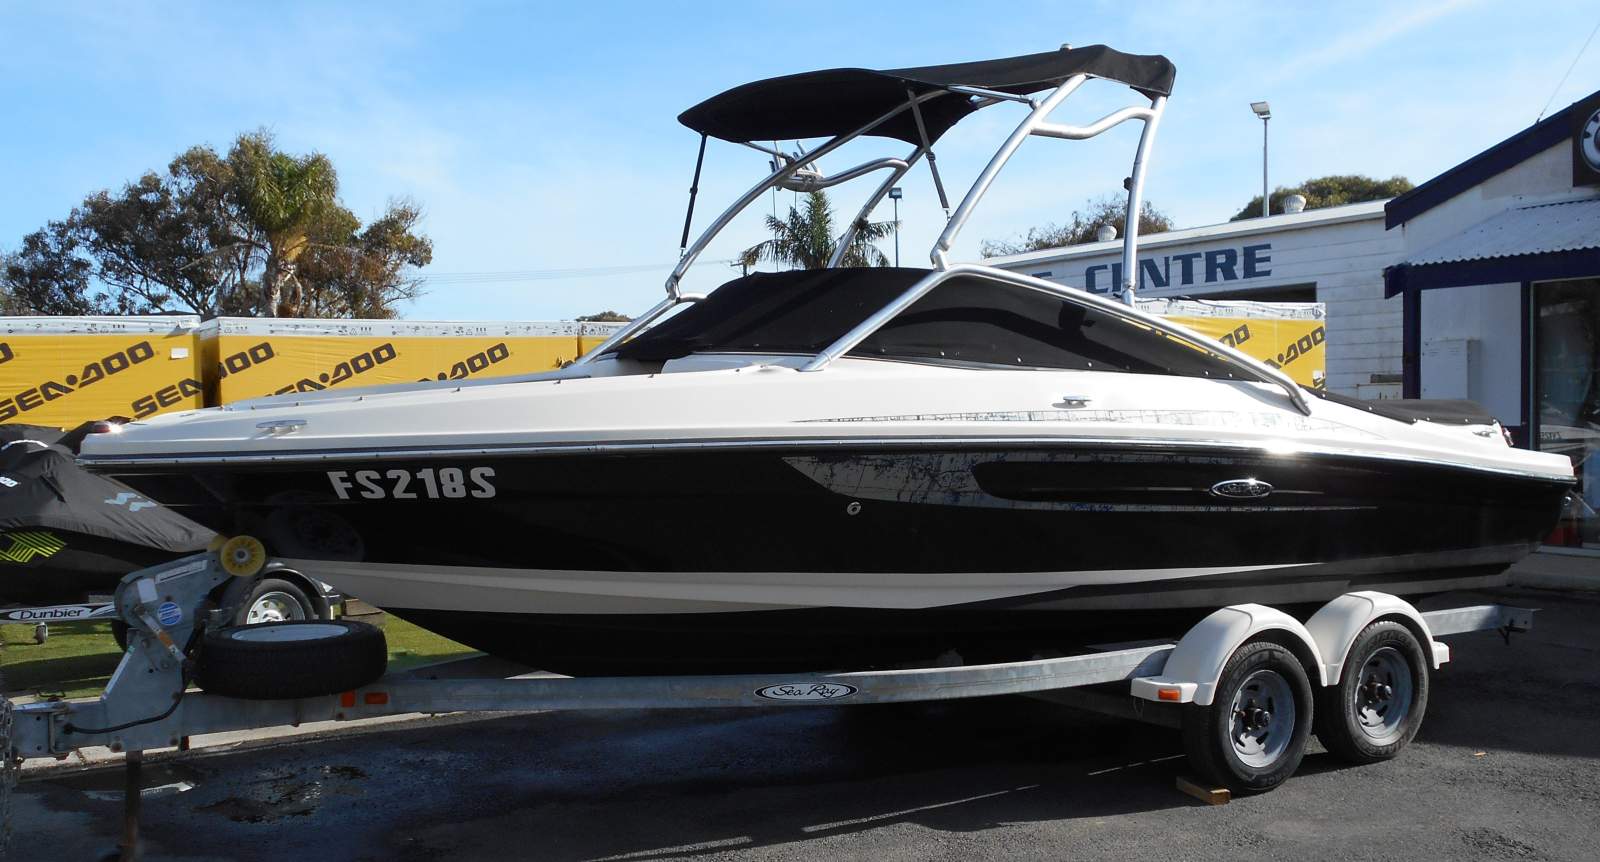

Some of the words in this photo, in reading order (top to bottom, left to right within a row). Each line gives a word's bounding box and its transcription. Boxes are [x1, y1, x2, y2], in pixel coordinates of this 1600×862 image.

[327, 467, 496, 499] FS218S
[20, 609, 84, 619] Dunbier
[773, 685, 804, 696] Sea
[807, 684, 840, 698] Ray
